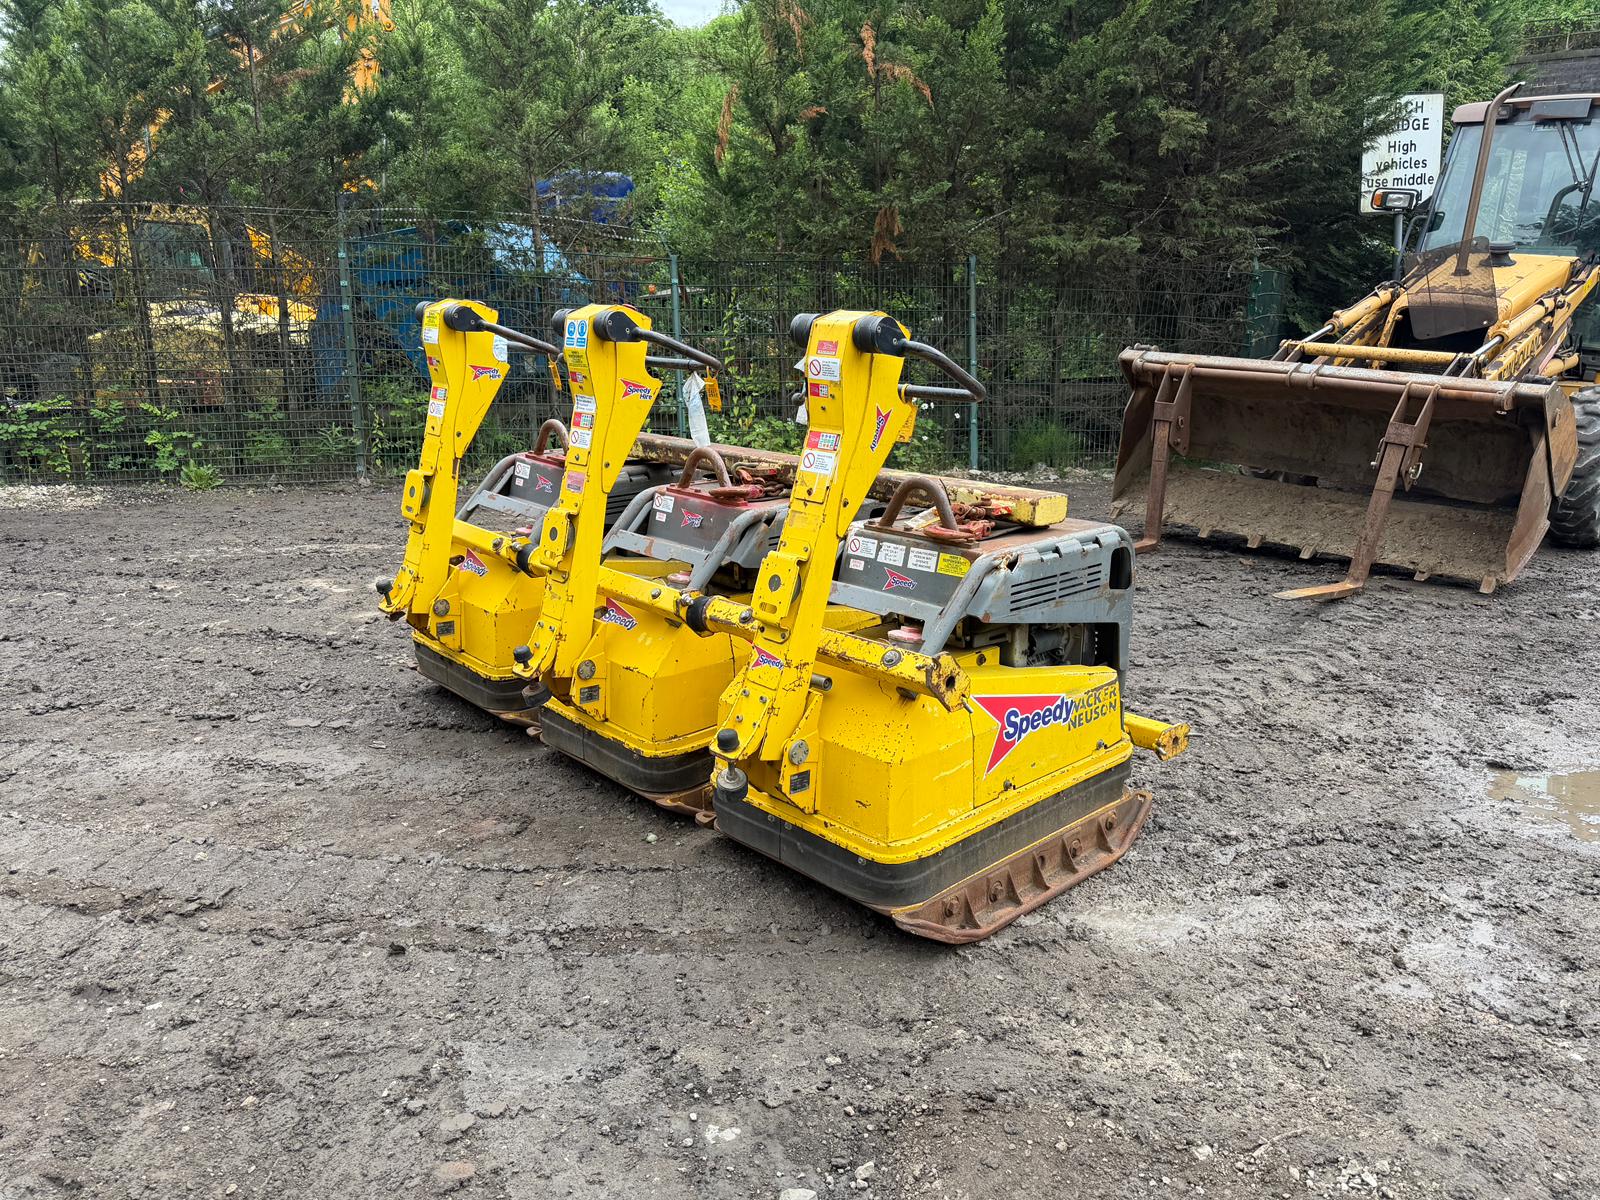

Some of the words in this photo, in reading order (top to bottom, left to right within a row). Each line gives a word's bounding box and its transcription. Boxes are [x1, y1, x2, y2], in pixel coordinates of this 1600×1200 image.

[1388, 139, 1417, 155] High
[1376, 156, 1428, 170] vehicles
[1366, 178, 1388, 188] use
[1392, 172, 1435, 187] middle
[476, 367, 499, 377] Speedy
[626, 385, 652, 395] Speedy
[869, 415, 885, 453] Speedy
[463, 559, 489, 577] Speedy
[891, 576, 917, 590] Speedy
[603, 608, 638, 631] Speedy
[759, 654, 784, 670] Speedy
[1004, 696, 1075, 743] Speedy
[1068, 698, 1117, 732] NEUSON
